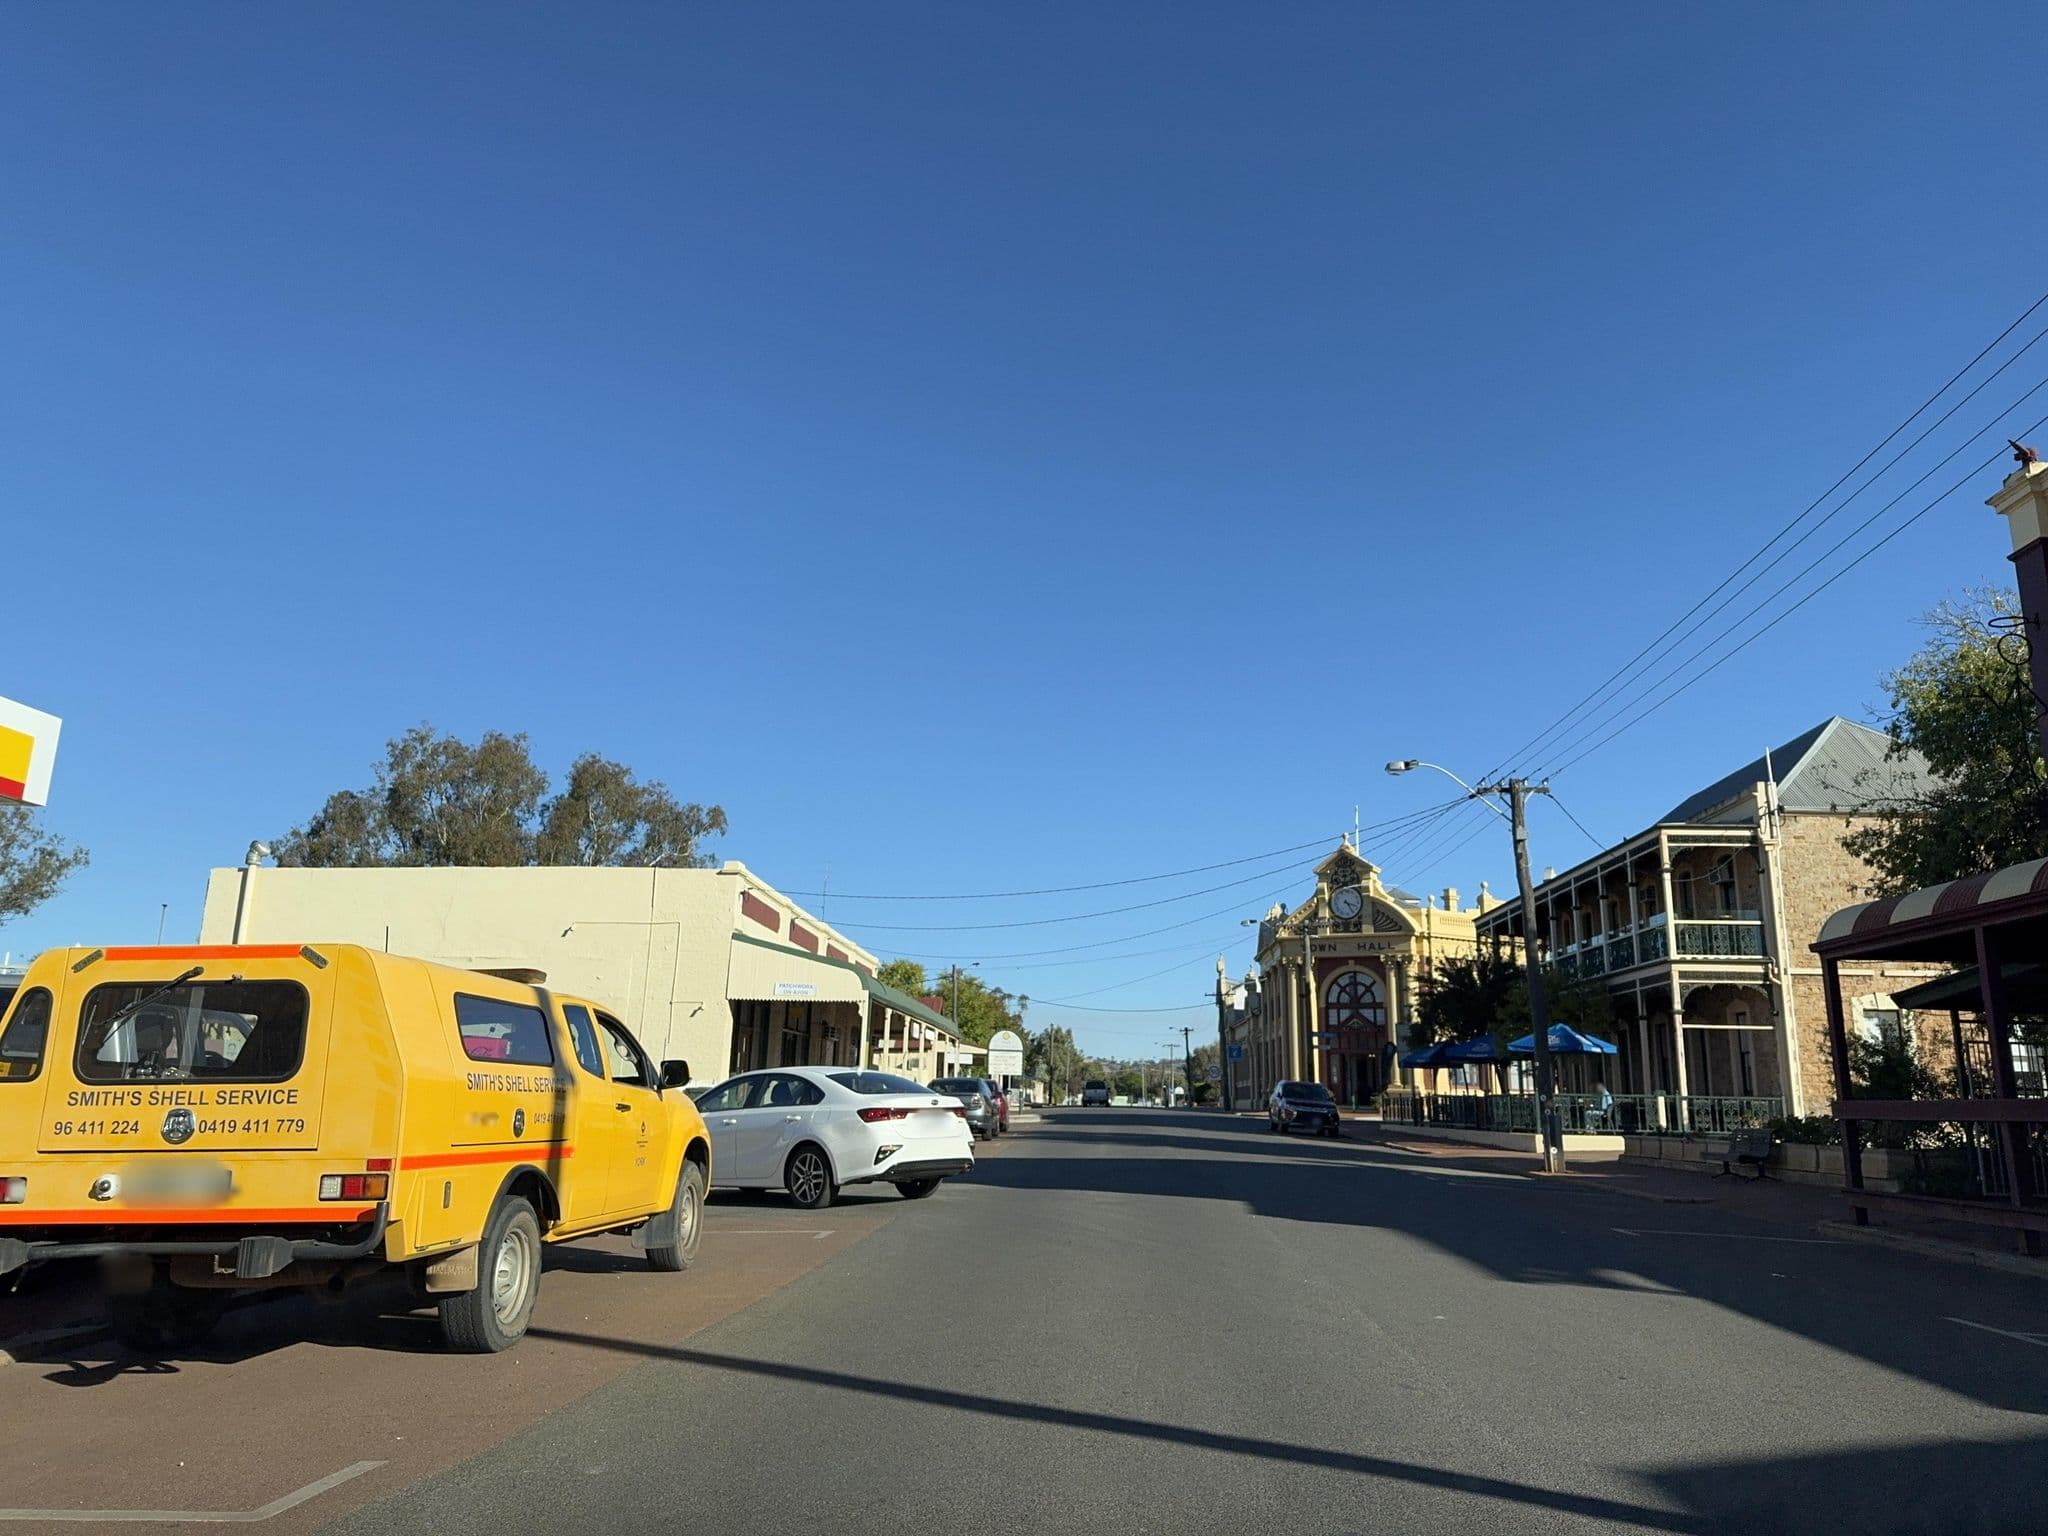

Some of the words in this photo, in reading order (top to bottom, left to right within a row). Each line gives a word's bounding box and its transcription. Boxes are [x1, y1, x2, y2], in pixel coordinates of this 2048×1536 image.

[1357, 941, 1395, 951] HALL
[466, 1073, 504, 1091] SMITH'S
[505, 1075, 532, 1093] SHELL
[67, 1091, 142, 1106] SMITH'S
[148, 1090, 209, 1106] SHELL
[215, 1089, 299, 1105] SERVICE
[533, 1112, 546, 1124] 0419
[53, 1121, 73, 1136] 96
[77, 1120, 105, 1135] 411
[110, 1120, 140, 1135] 224
[198, 1119, 237, 1134] 0419
[242, 1119, 270, 1133] 411
[276, 1118, 305, 1133] 779
